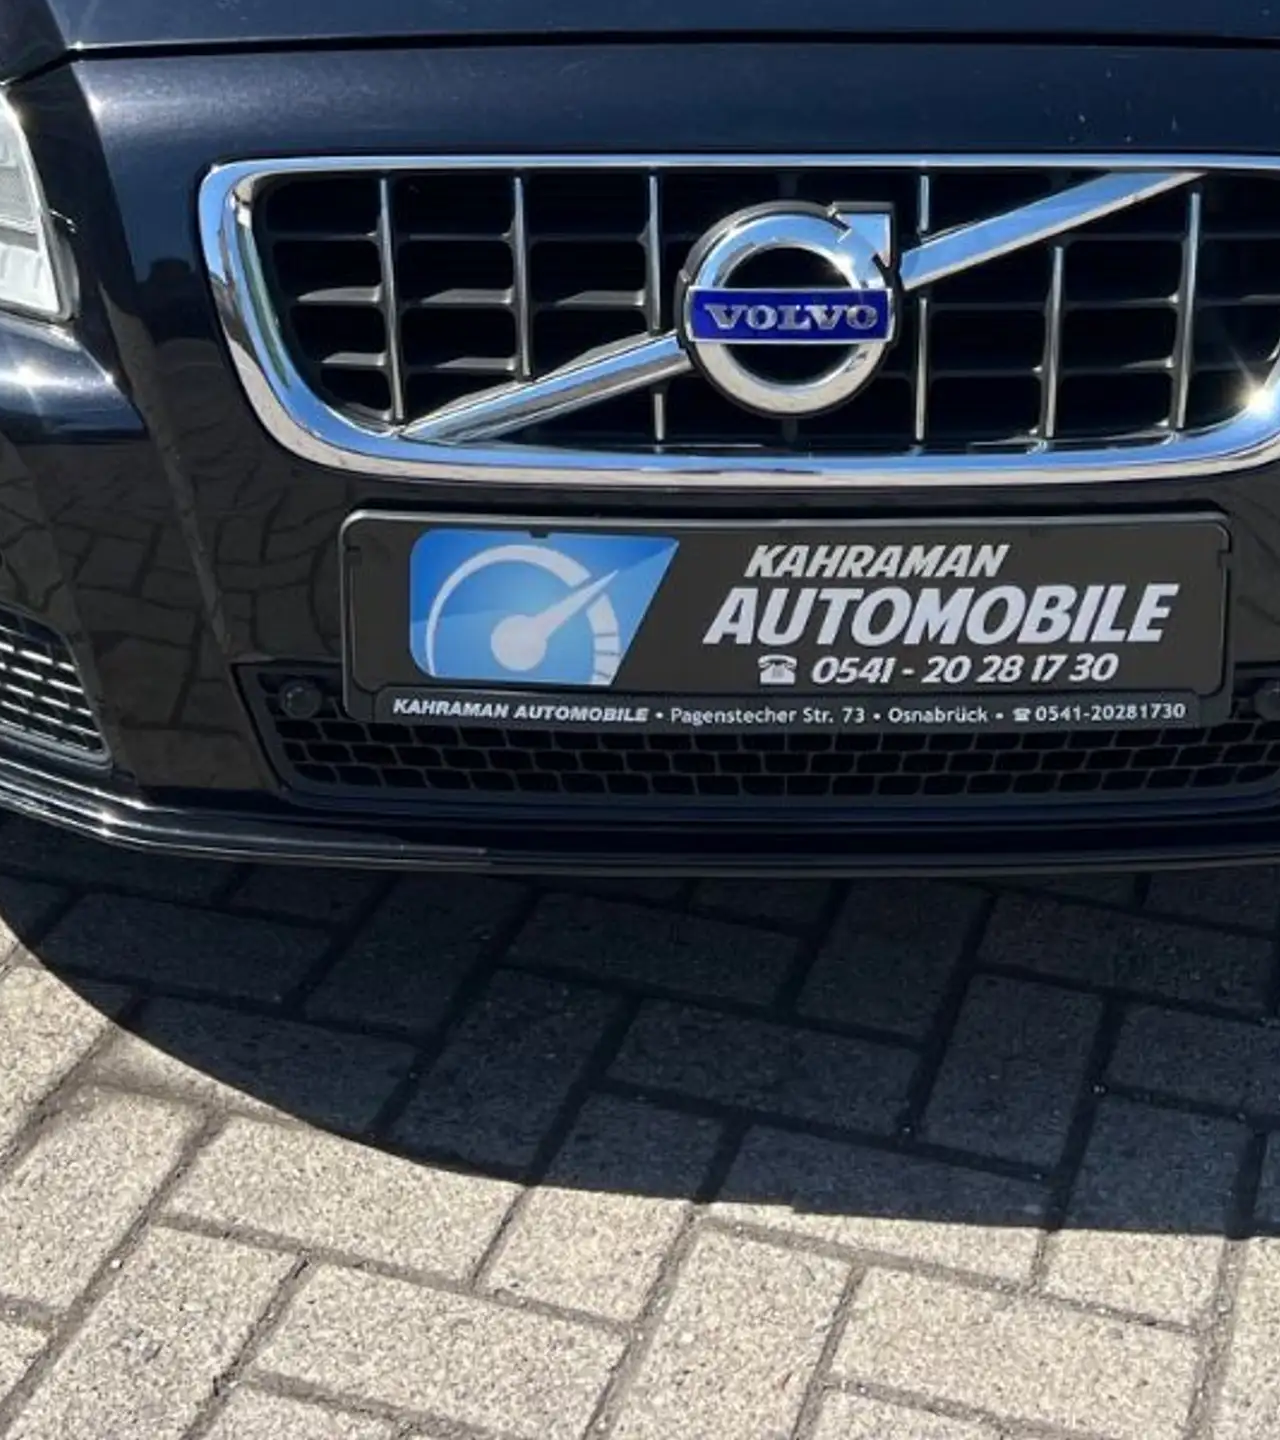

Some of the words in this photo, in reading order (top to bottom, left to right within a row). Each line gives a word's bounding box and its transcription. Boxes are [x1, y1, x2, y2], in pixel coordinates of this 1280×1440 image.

[703, 303, 879, 331] VOLVO
[744, 544, 1009, 578] KAHRAMAN
[702, 583, 1179, 646] AUTOMOBILE
[811, 655, 896, 685] 0541
[921, 654, 973, 684] 20
[976, 654, 1024, 684] 28
[1031, 653, 1069, 683] 17
[1069, 652, 1121, 683] 30
[393, 698, 509, 719] KAHRAMAN
[513, 706, 650, 723] AUTOMOBILE
[671, 707, 797, 726] Pagenstecher
[803, 708, 834, 723] Str.
[842, 708, 866, 723] 73
[888, 707, 989, 723] Osnabrück
[1034, 702, 1187, 722] 0541-20281730
